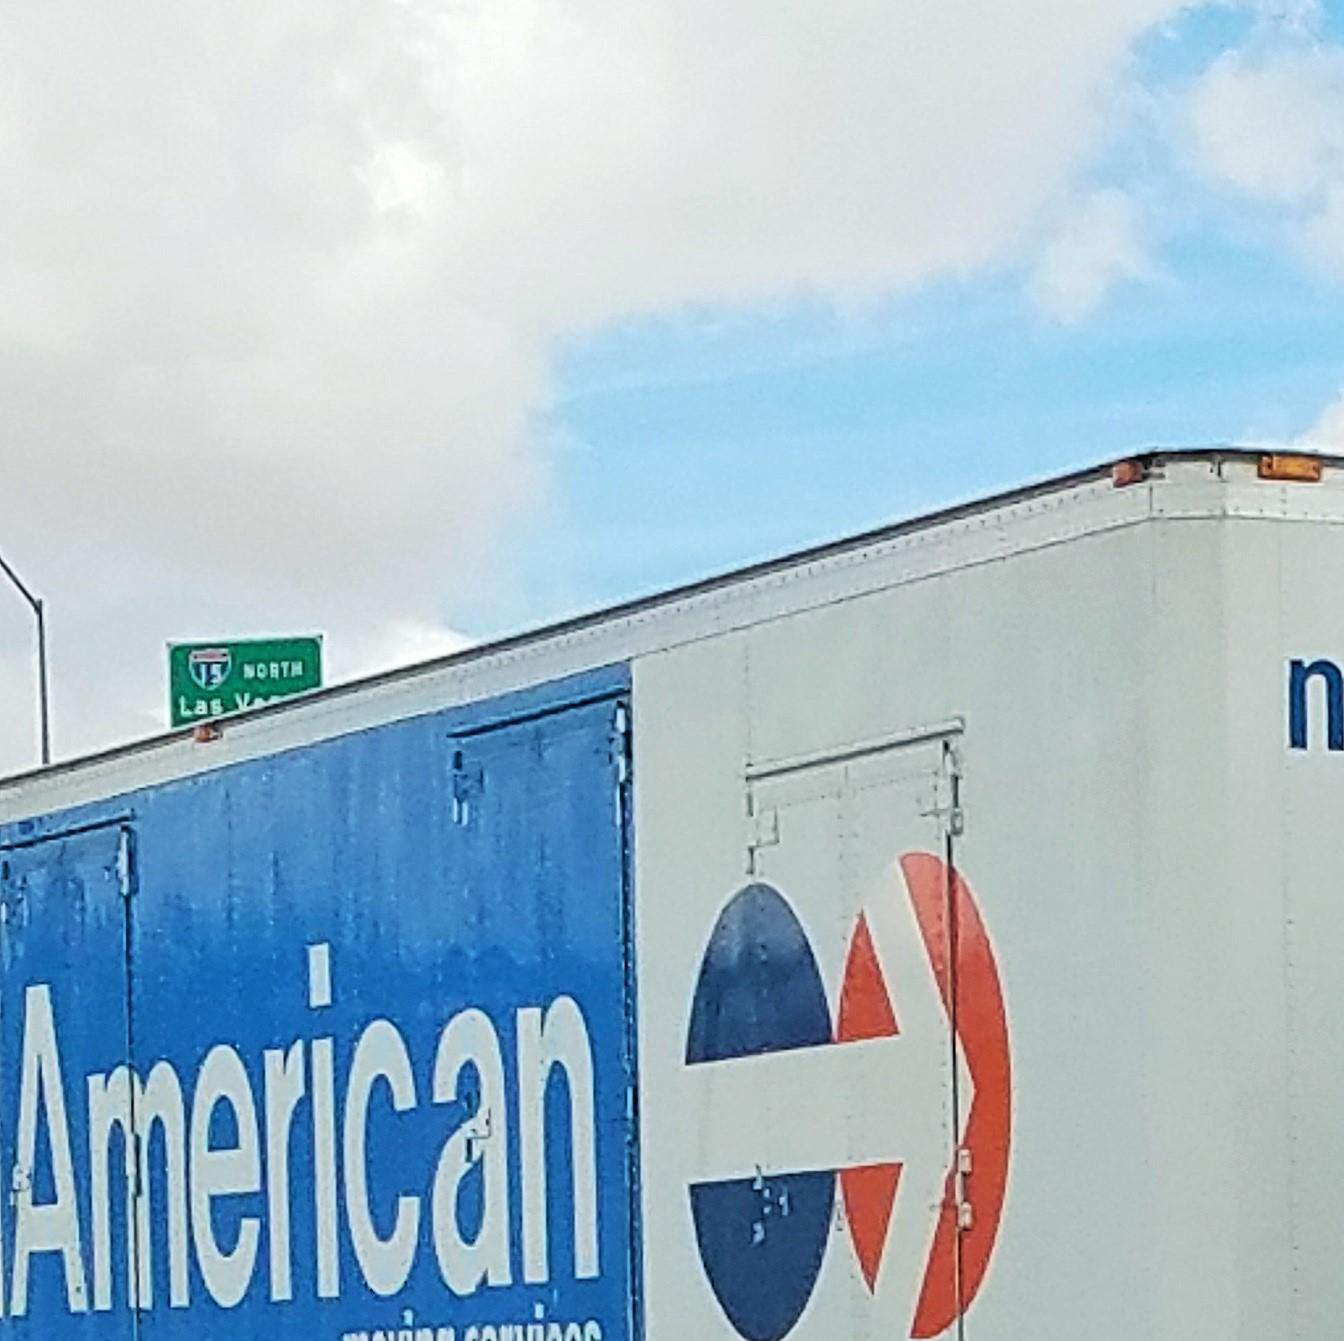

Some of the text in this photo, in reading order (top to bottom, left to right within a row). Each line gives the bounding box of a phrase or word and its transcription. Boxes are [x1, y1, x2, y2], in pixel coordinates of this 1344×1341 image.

[243, 661, 303, 680] NORTH
[179, 695, 223, 717] Las
[10, 942, 601, 1317] American
